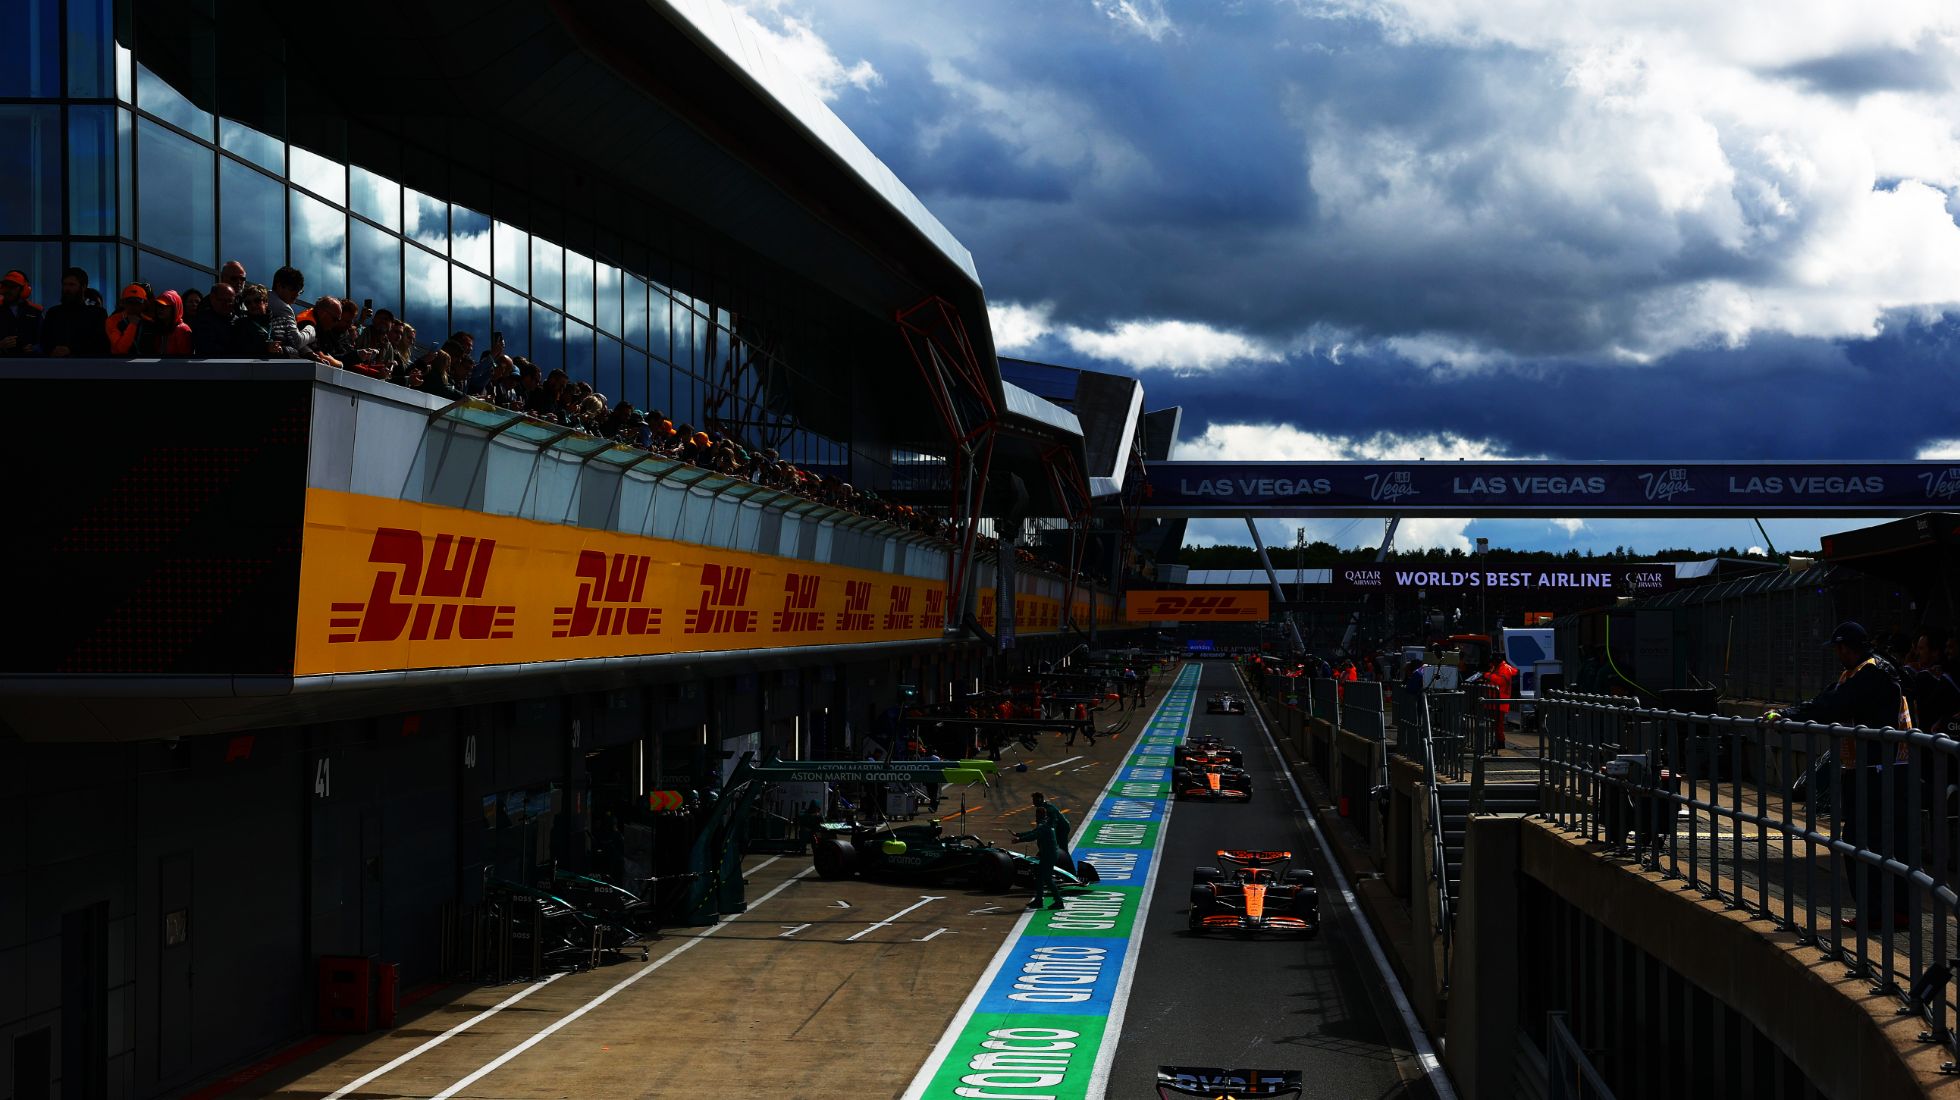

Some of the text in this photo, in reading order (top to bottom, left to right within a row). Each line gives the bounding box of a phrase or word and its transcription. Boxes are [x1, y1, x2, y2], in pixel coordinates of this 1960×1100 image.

[1180, 478, 1332, 496] LAS VEGAS
[1453, 476, 1606, 495] LAS VEGAS
[1729, 475, 1885, 494] LAS VEGAS
[357, 527, 497, 642] DHL
[567, 550, 652, 638] DHL
[1344, 570, 1381, 581] QATAR
[1395, 571, 1612, 588] WORLD'S BEST AIRLINE
[694, 563, 751, 634] DHL
[779, 573, 821, 632] DHL
[842, 580, 872, 631] DHL
[1154, 596, 1242, 615] DHL
[464, 735, 476, 768] 40
[315, 757, 330, 798] 41
[790, 772, 912, 781] ASTON MARTIN aramco
[1007, 946, 1108, 1003] aramco
[954, 1027, 1081, 1100] ramco
